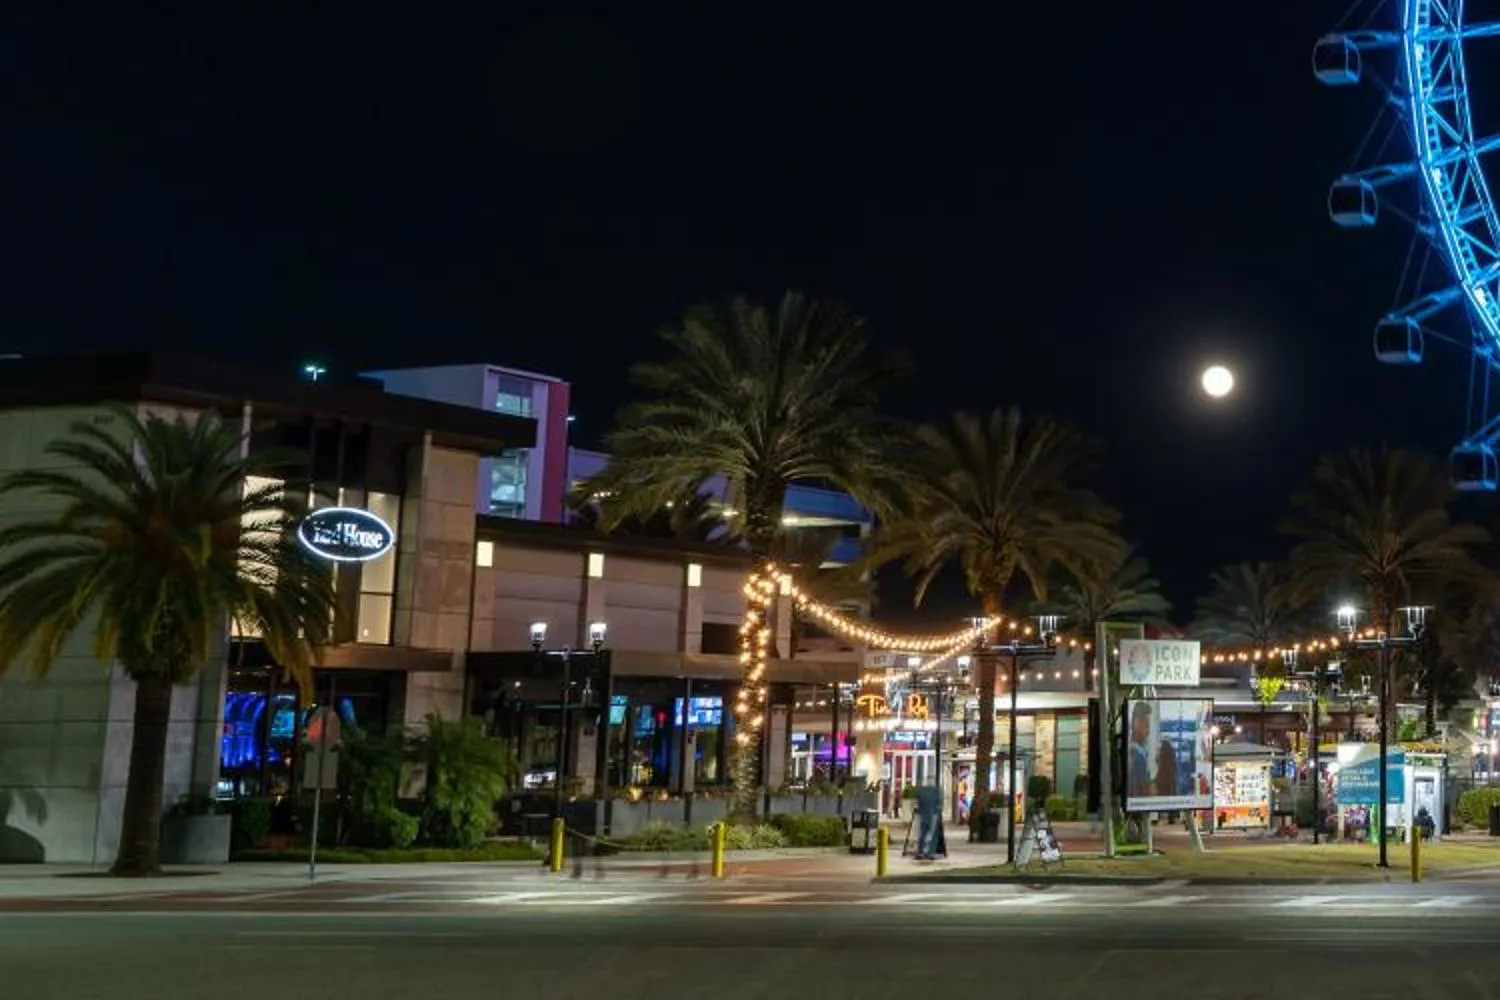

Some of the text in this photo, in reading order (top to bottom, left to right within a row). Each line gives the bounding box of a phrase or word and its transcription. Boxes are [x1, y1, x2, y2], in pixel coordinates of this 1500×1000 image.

[344, 523, 383, 549] House
[1155, 645, 1193, 662] ICON
[1155, 664, 1192, 681] PARK
